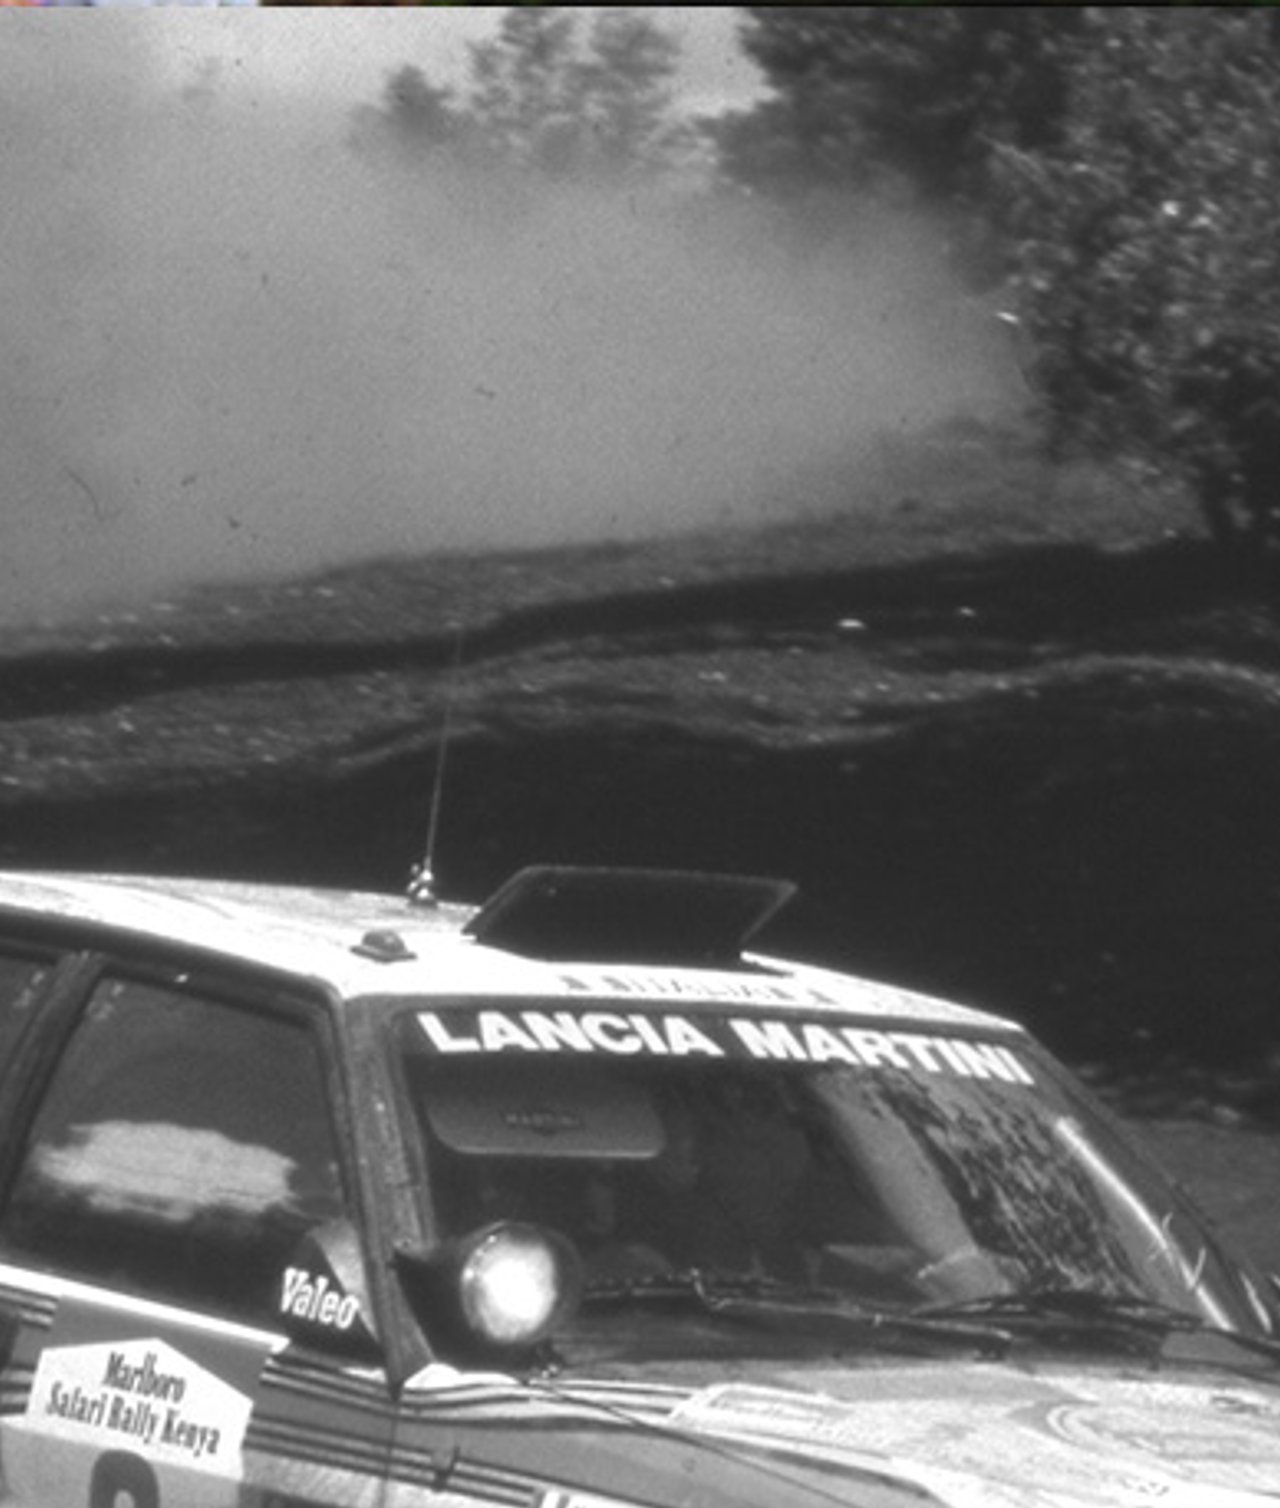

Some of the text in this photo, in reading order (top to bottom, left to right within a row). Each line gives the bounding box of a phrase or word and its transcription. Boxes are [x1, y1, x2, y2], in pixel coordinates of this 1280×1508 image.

[418, 1011, 1035, 1086] LANCIA MARTINI
[281, 1266, 360, 1330] Valeo
[102, 1350, 187, 1403] Marlboro
[44, 1380, 221, 1457] Safari Rally Kenya
